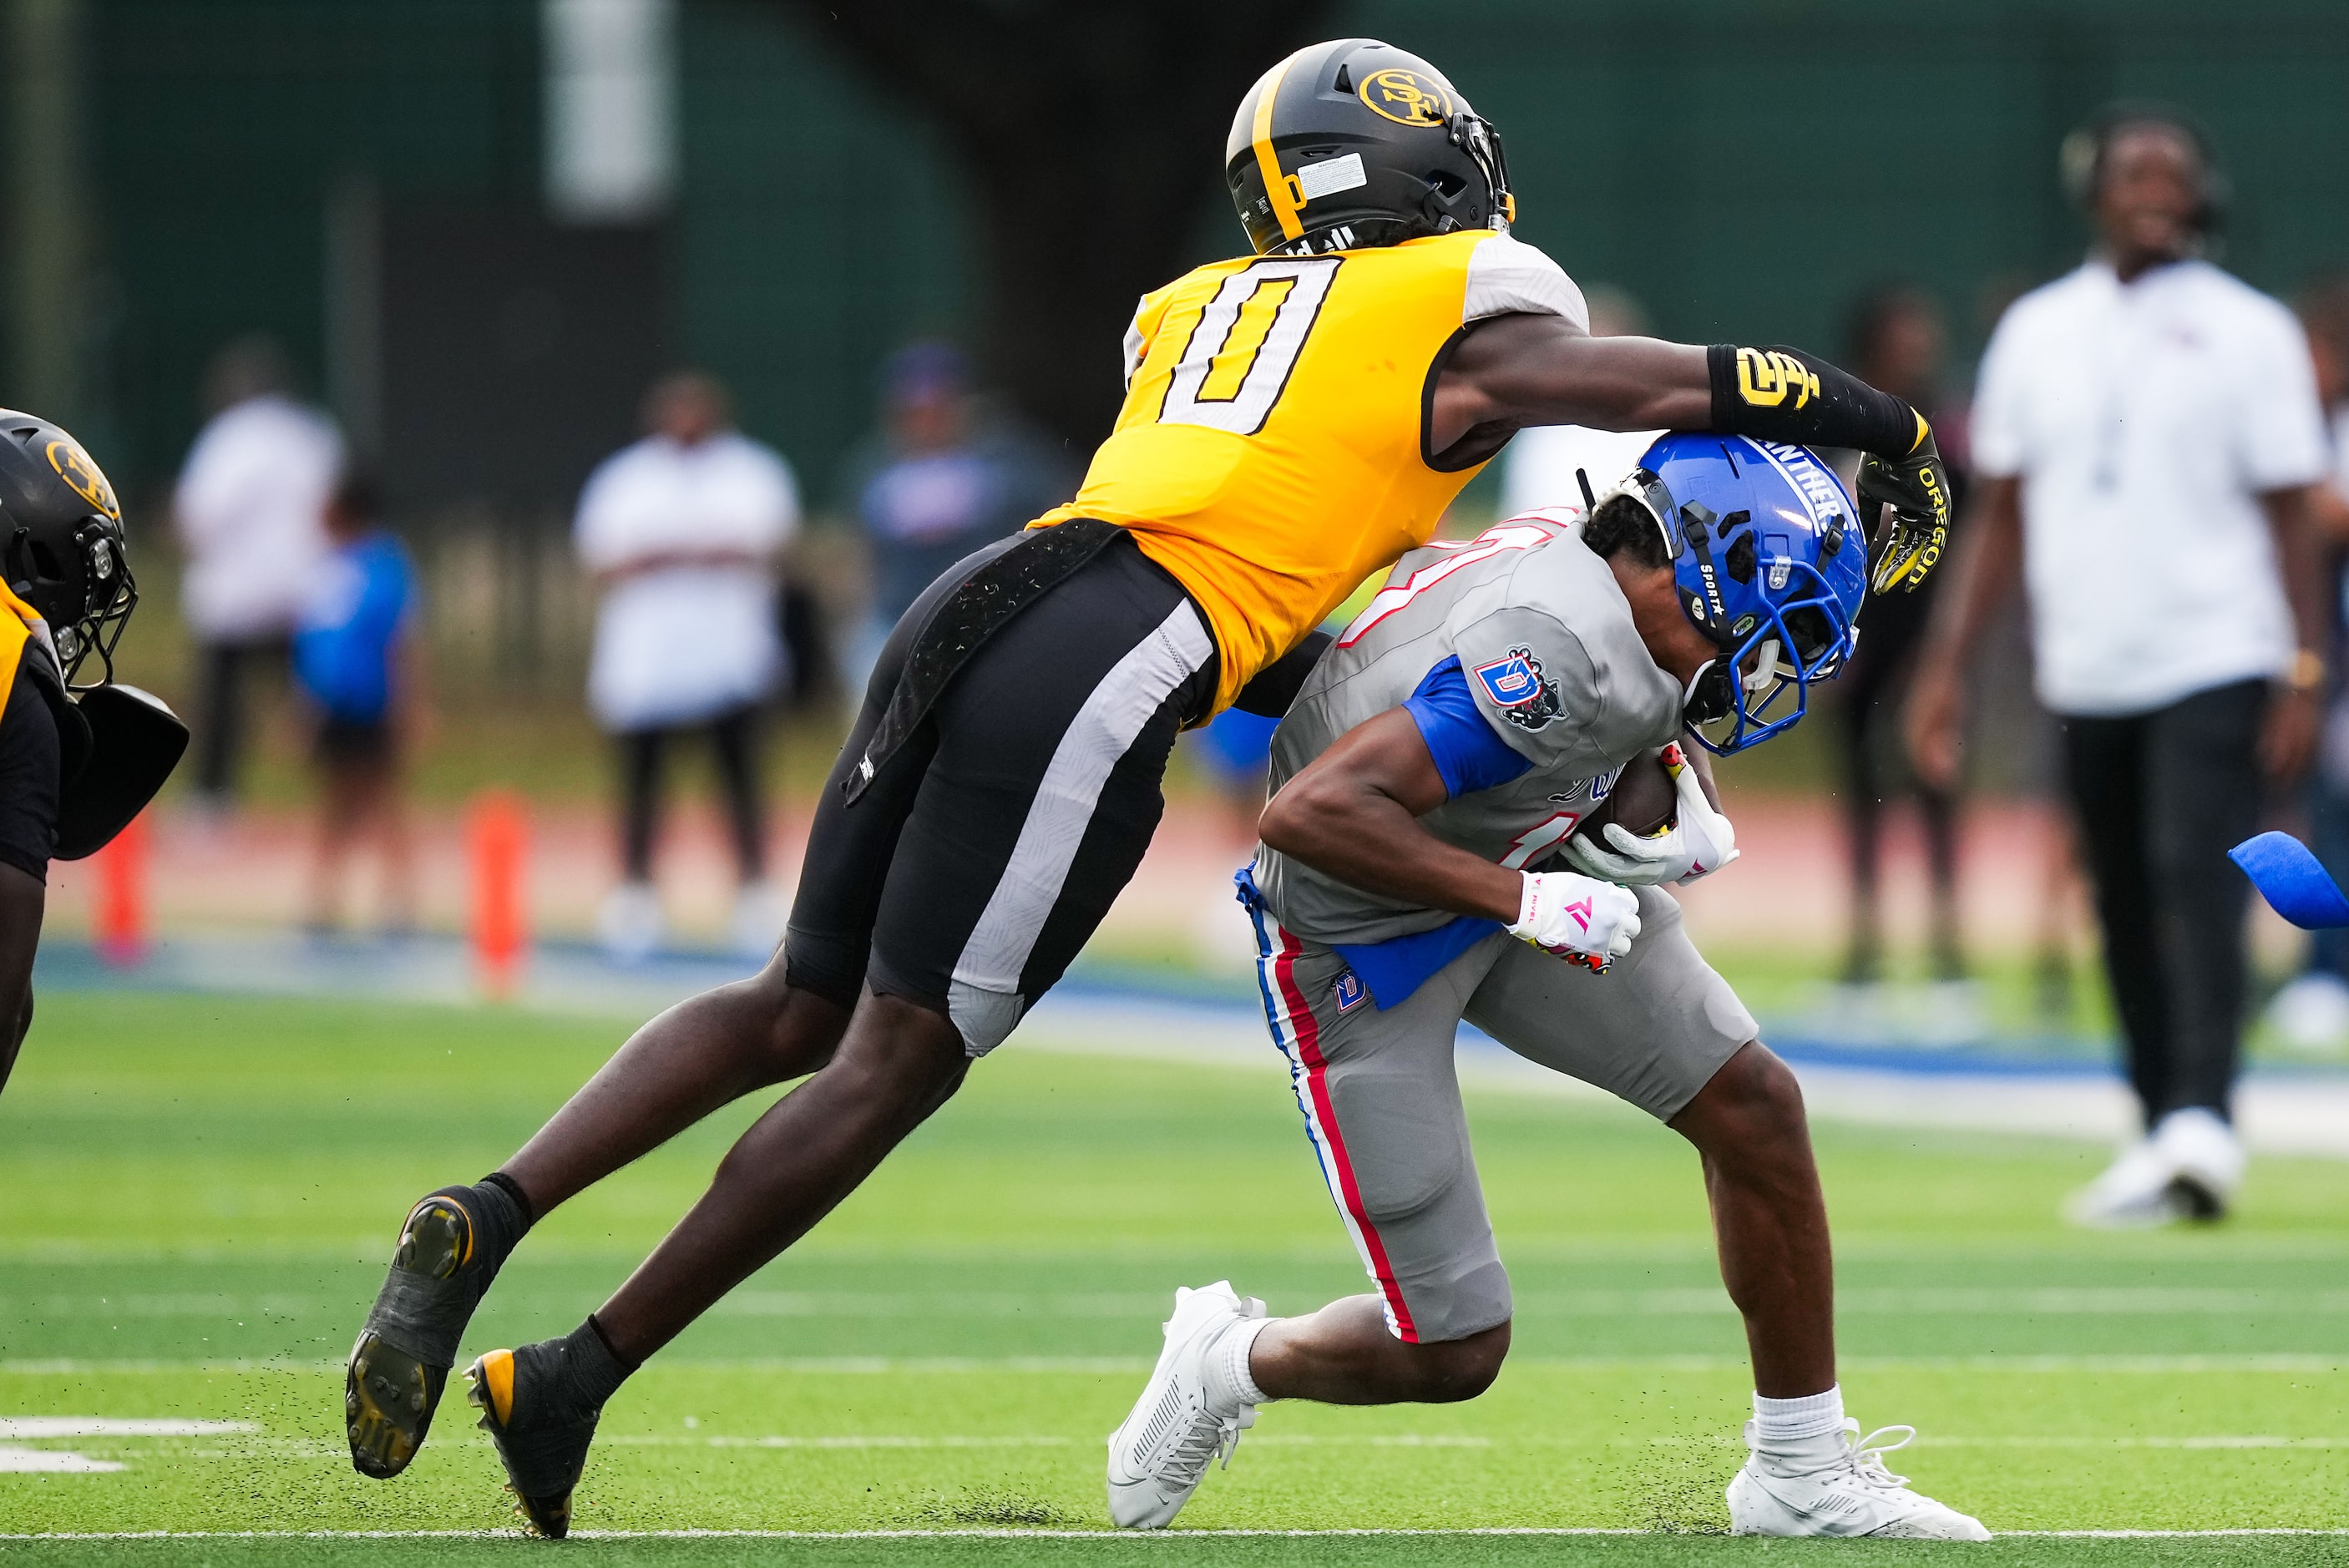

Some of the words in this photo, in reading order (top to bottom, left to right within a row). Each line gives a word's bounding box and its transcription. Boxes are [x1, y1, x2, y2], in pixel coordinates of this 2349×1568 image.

[1377, 73, 1440, 123] SF
[1156, 255, 1346, 436] 0
[1909, 468, 1947, 584] OREGON
[1700, 564, 1720, 606] SPORT
